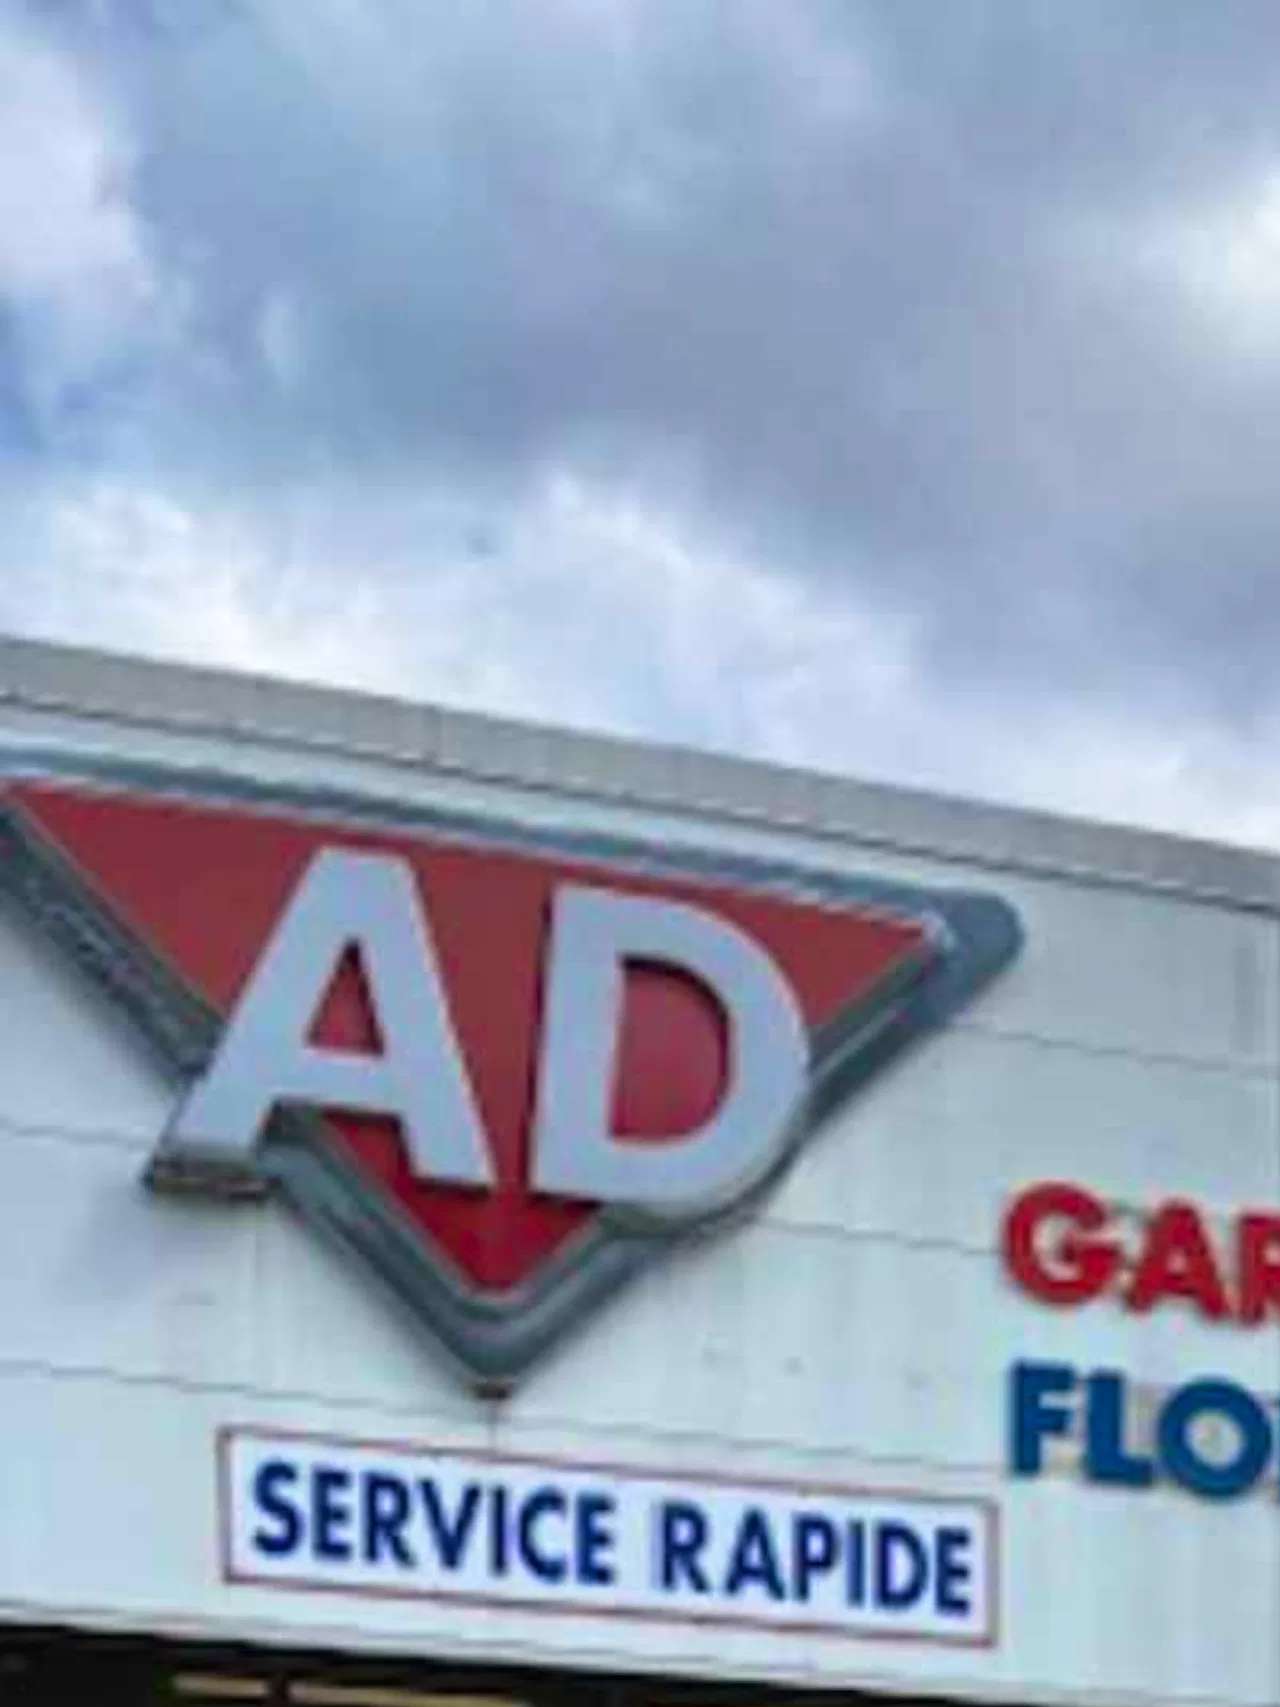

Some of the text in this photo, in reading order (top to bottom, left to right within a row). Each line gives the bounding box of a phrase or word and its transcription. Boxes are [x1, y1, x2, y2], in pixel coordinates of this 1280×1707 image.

[156, 842, 813, 1222] AD
[252, 1459, 972, 1618] SERVICE RAPIDE
